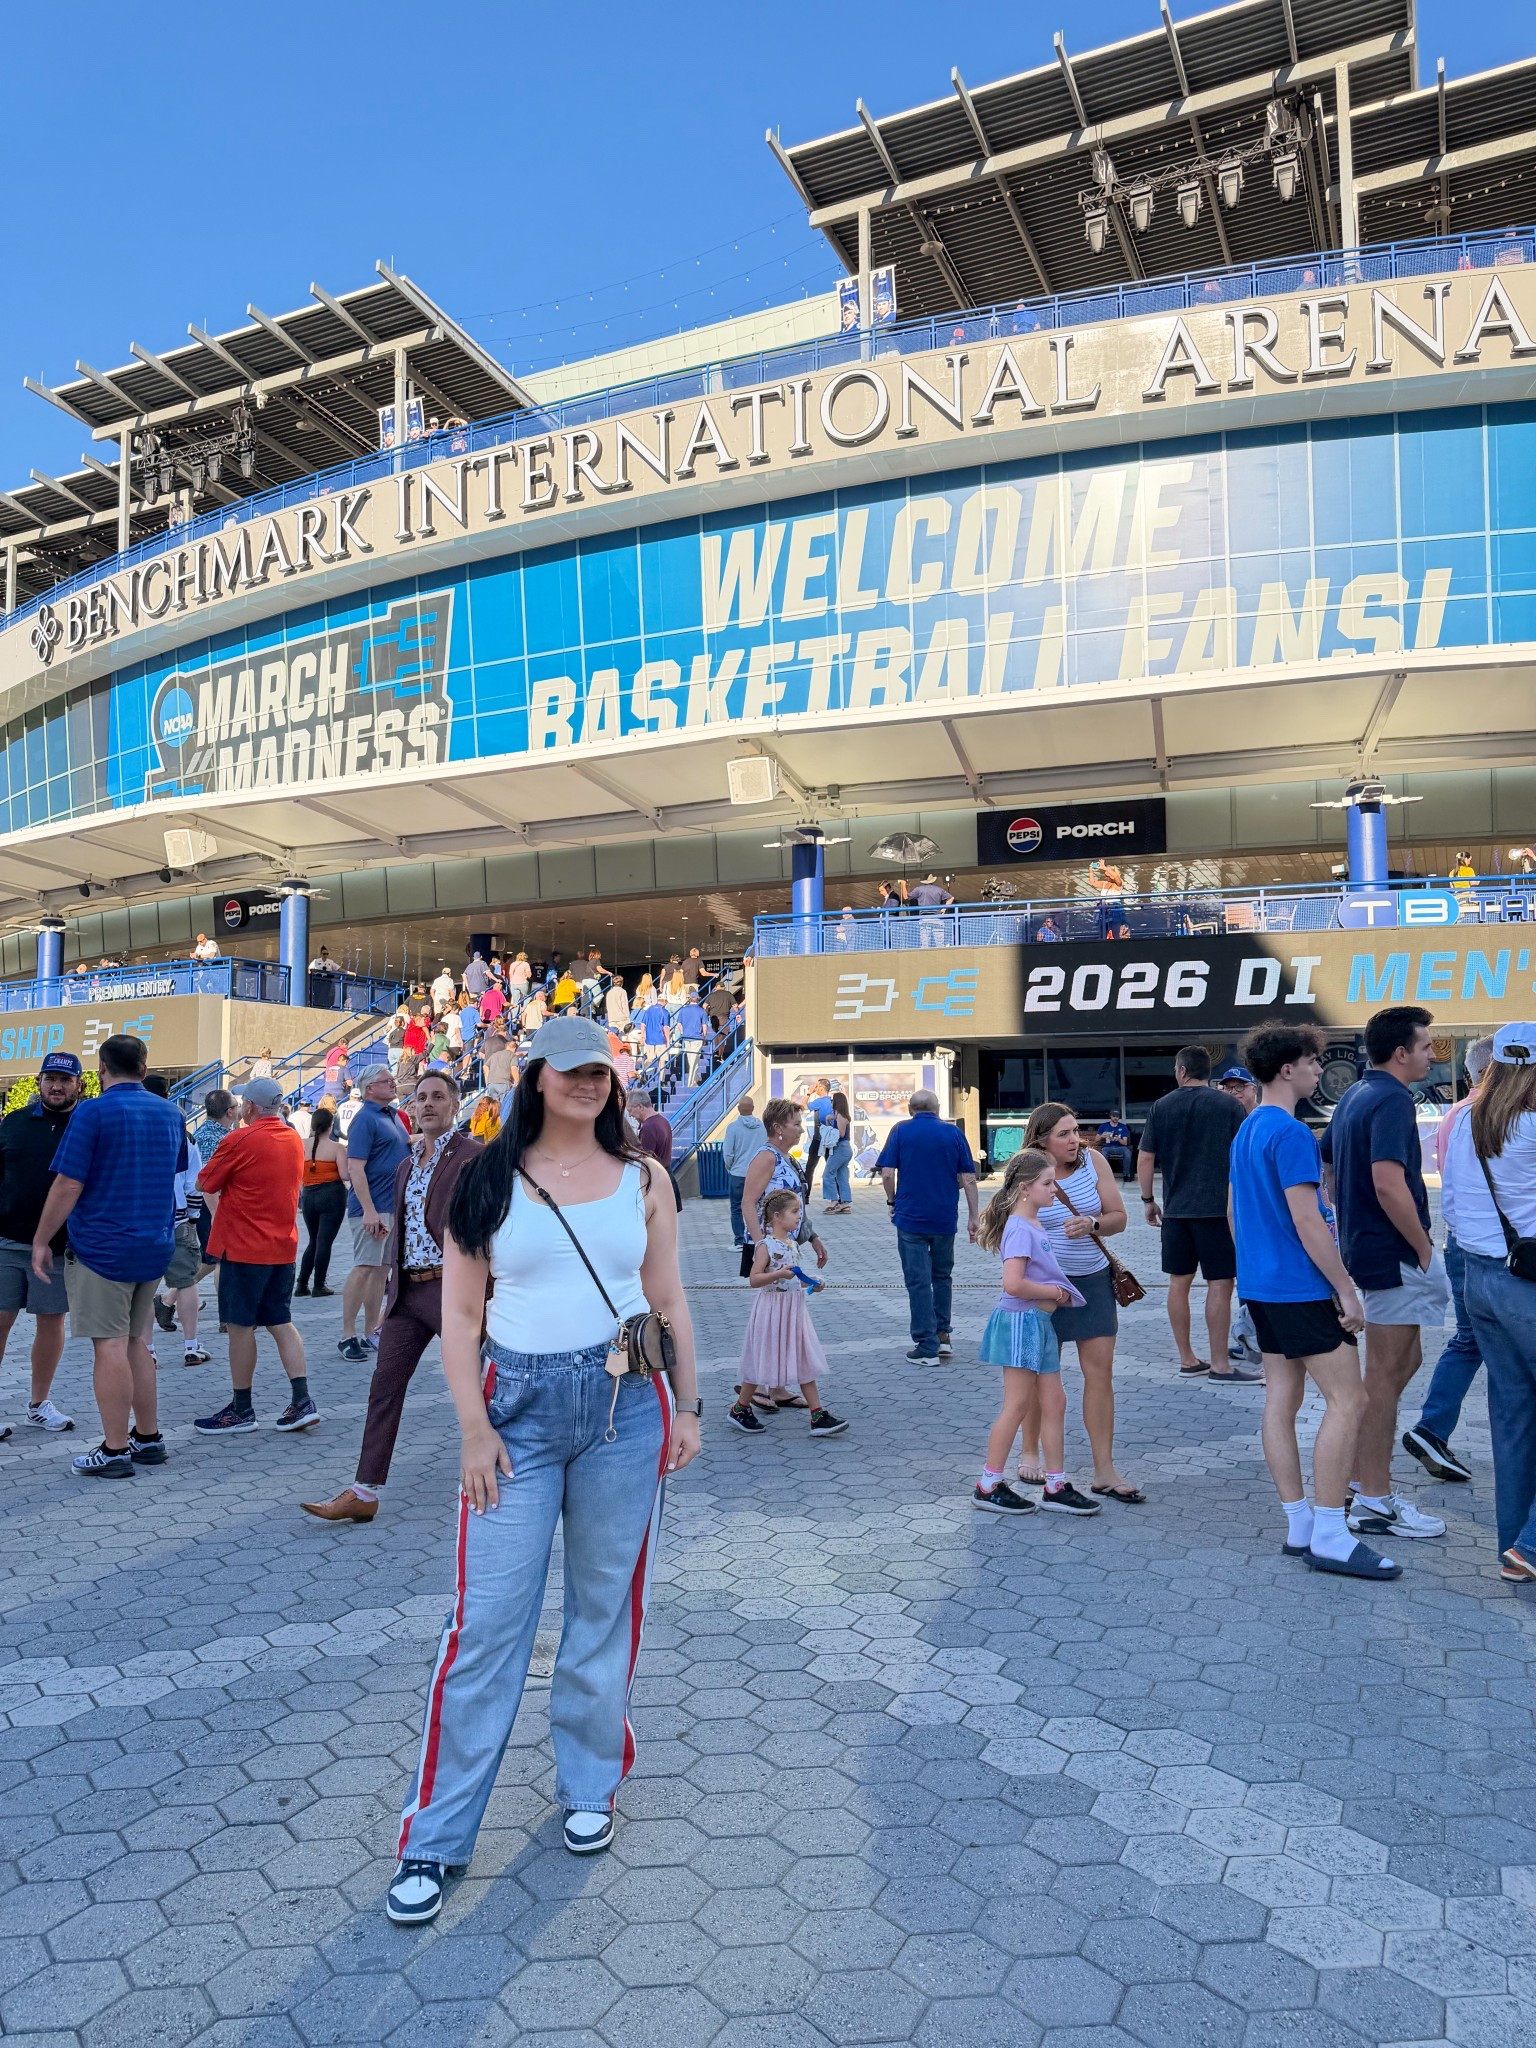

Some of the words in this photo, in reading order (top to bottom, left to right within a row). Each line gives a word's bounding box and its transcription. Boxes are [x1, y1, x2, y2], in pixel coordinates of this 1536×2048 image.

[65, 489, 372, 651] BENCHMARK
[393, 334, 1101, 540] INTERNATIONAL
[1142, 275, 1536, 399] ARENA
[702, 461, 1194, 635] WELCOME
[196, 642, 349, 747] MARCH
[163, 712, 192, 736] NCAA
[218, 701, 441, 793] MADNESS
[1009, 831, 1040, 840] PEPSI
[1056, 821, 1135, 840] PORCH
[88, 984, 135, 1001] PREMIUM
[136, 979, 173, 997] ENTRY
[1024, 960, 1211, 1012] 2026
[1234, 955, 1322, 1006] DI
[1346, 949, 1536, 1003] MEN'
[341, 1109, 353, 1120] 10
